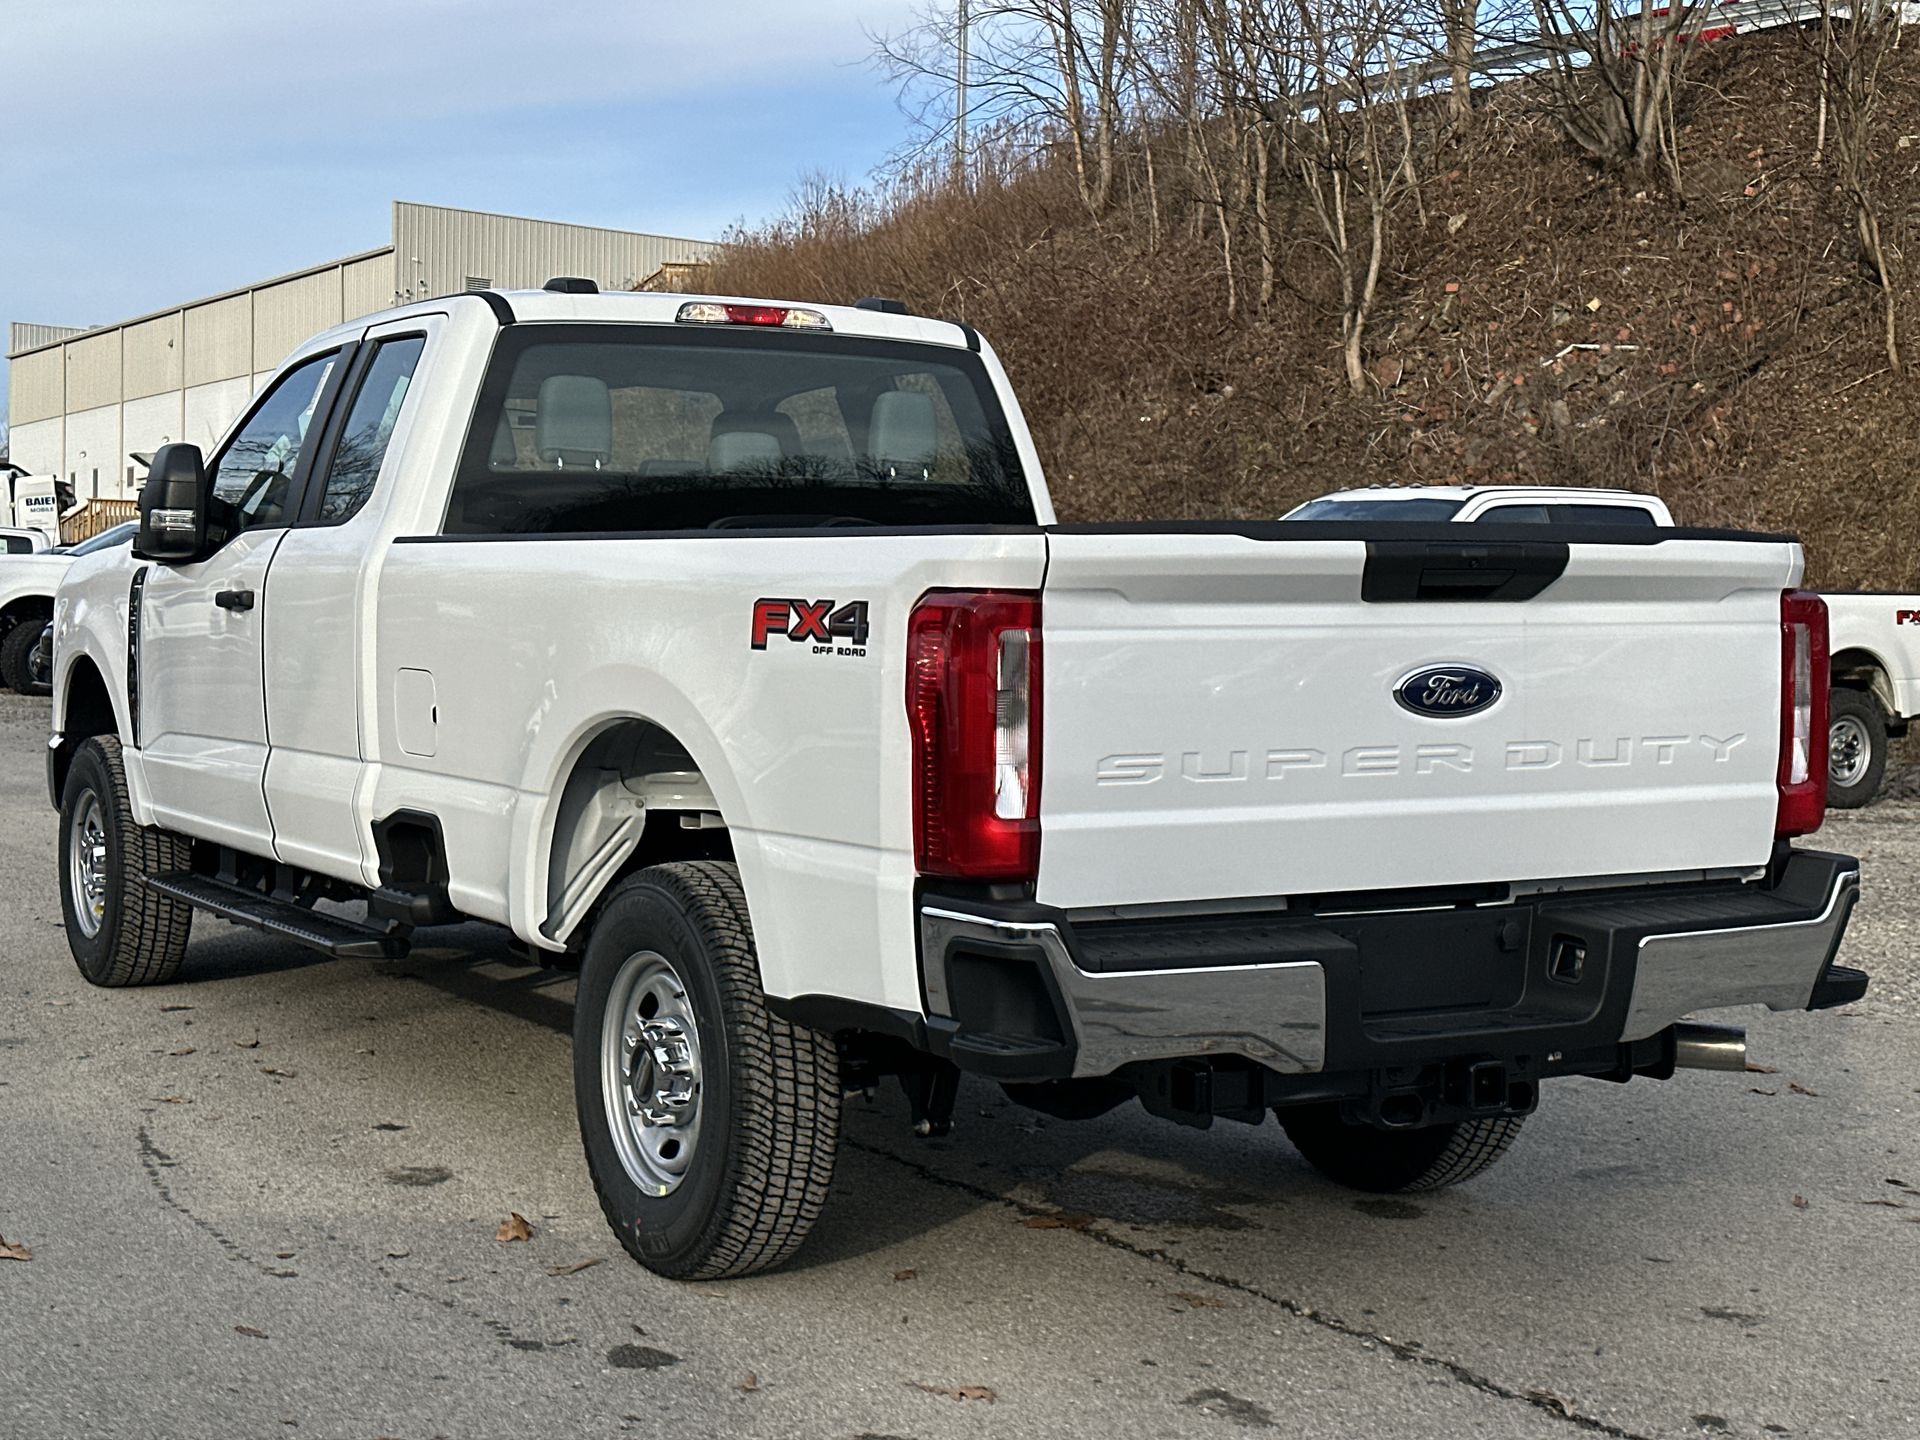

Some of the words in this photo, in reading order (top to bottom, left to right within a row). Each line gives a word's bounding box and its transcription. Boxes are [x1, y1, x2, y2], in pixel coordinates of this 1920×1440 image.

[751, 597, 869, 651] FX4
[812, 646, 834, 655] OFF
[837, 647, 867, 657] ROAD
[1422, 674, 1480, 705] Ford
[1096, 743, 1474, 786] SUPER
[1504, 733, 1747, 772] DUTY
